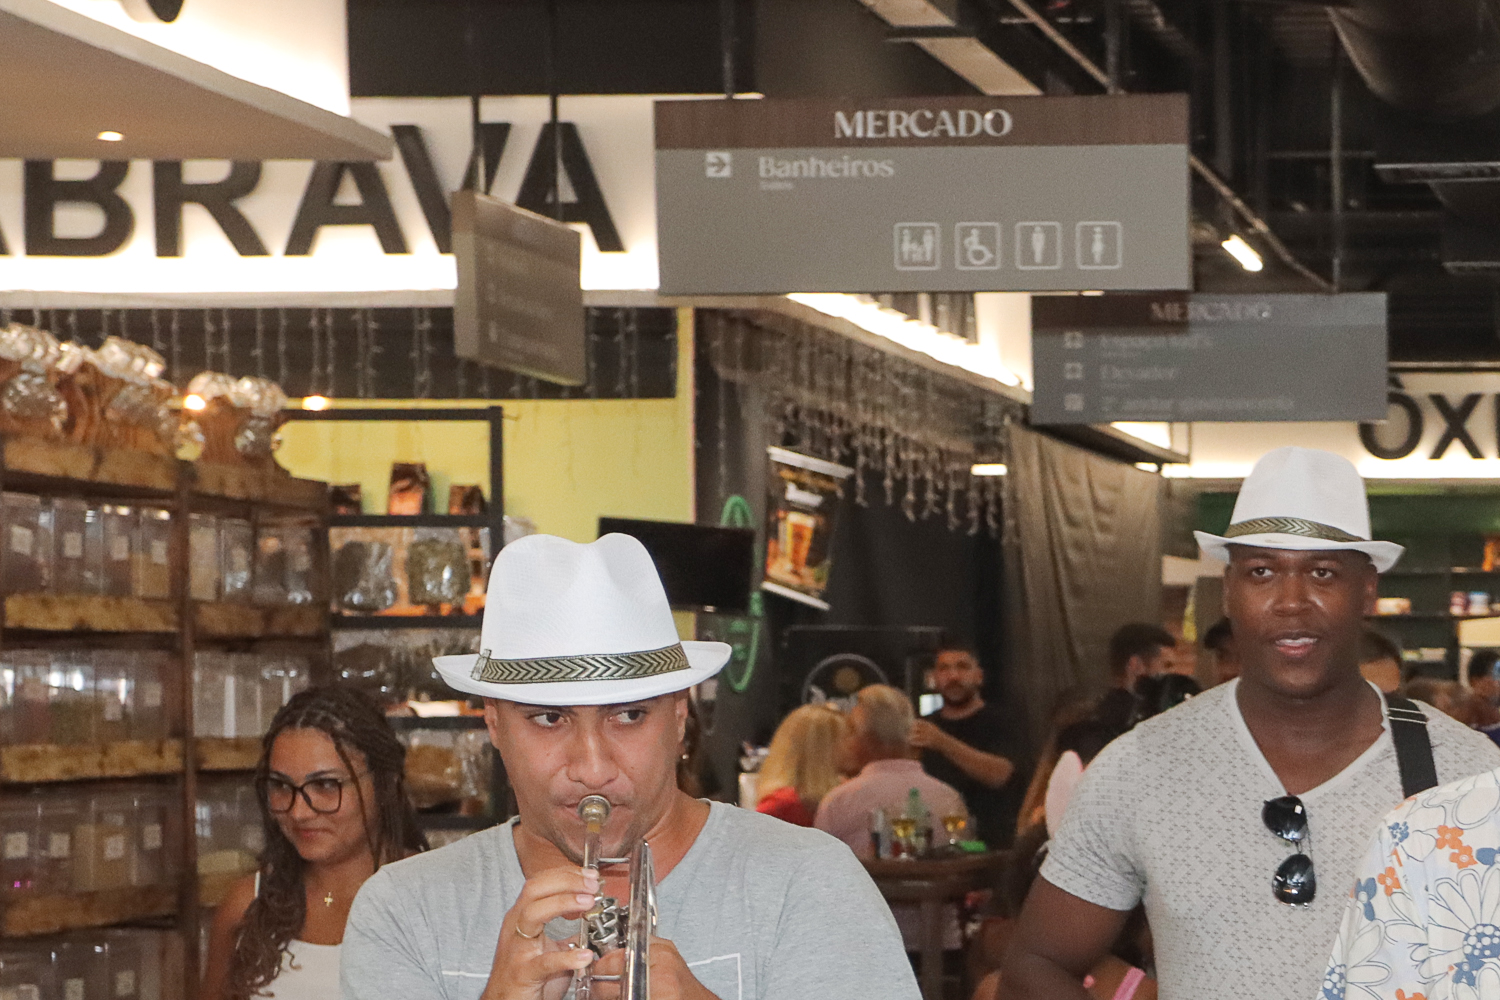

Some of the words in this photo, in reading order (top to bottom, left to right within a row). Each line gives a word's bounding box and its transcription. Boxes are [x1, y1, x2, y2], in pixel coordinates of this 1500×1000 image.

[834, 109, 1013, 138] MERCADO
[759, 155, 894, 178] Banheiros
[0, 122, 627, 257] BRAVA
